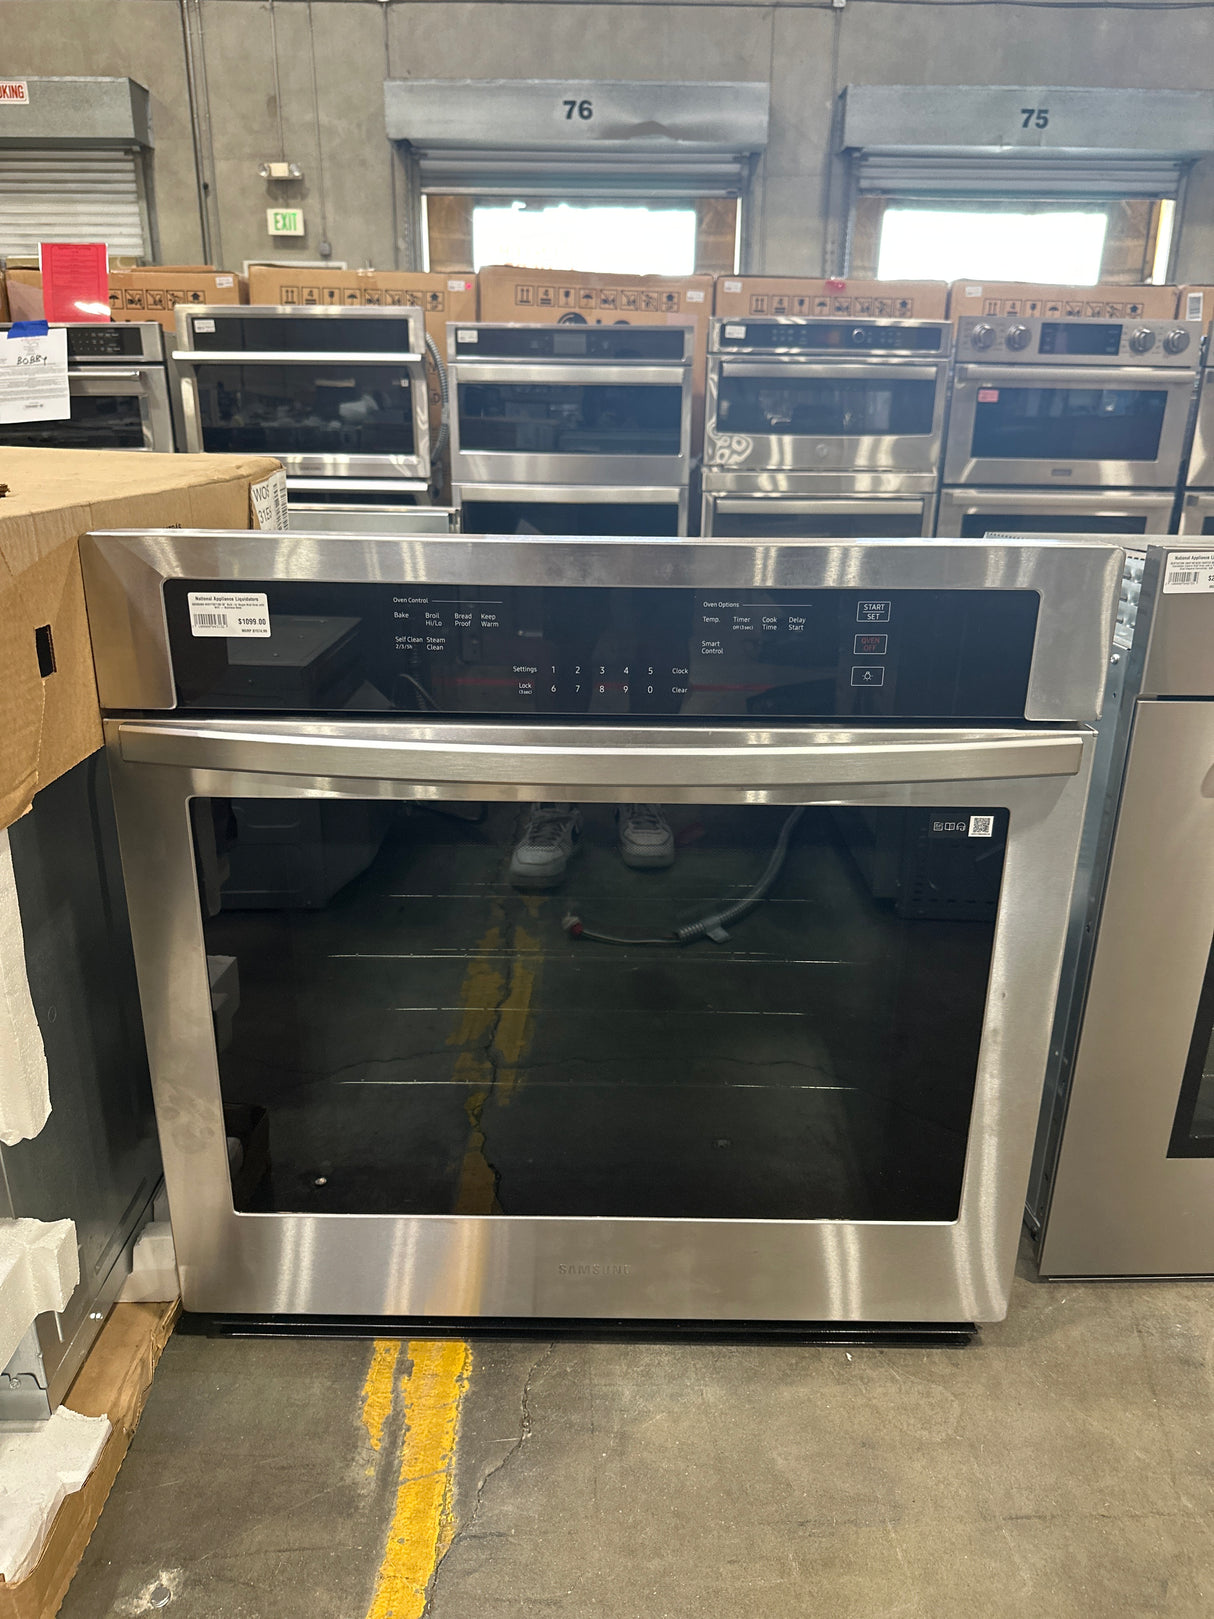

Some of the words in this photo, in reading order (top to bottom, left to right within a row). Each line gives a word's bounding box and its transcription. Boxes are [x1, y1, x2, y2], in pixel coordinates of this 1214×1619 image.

[562, 100, 593, 120] 76
[1021, 109, 1049, 129] 75
[273, 212, 297, 231] EXIT
[513, 666, 538, 674] Settings
[552, 666, 556, 674] 1
[576, 666, 580, 674] 2
[600, 666, 604, 674] 3
